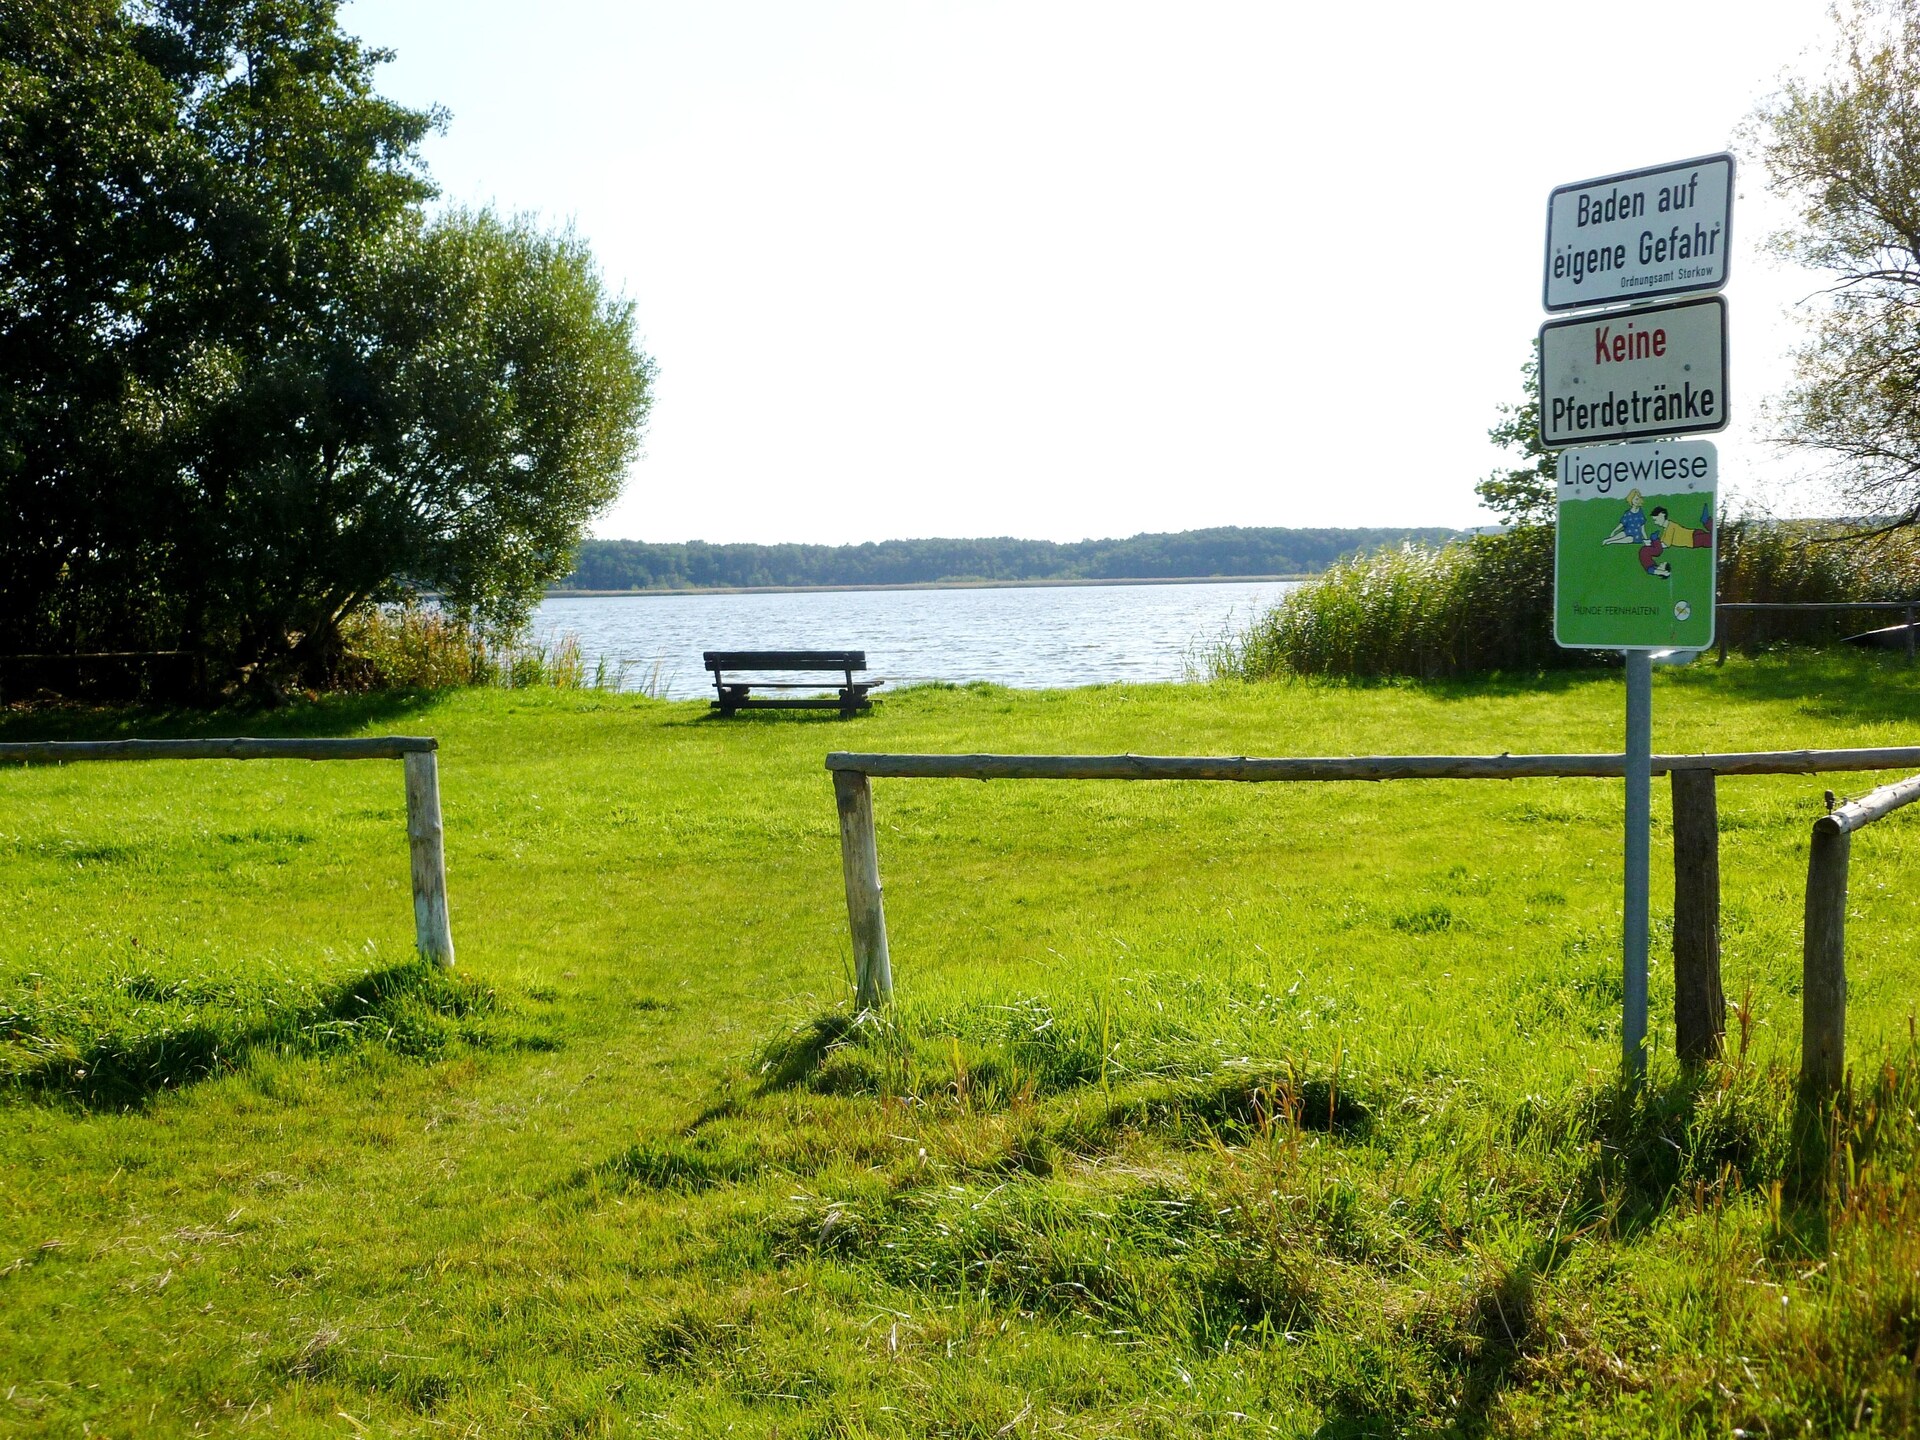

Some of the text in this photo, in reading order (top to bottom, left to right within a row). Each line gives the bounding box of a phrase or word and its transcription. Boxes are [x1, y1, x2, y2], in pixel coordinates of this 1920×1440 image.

[1577, 172, 1698, 228] Baden auf
[1554, 222, 1720, 284] eigene Gefahr
[1620, 266, 1713, 288] Ordnungsamt Storkow
[1595, 323, 1666, 365] Keine
[1552, 381, 1714, 433] Pferdetränke
[1564, 450, 1708, 493] Liegewiese
[1573, 605, 1660, 616] HUNDE FERNHALTEN!
